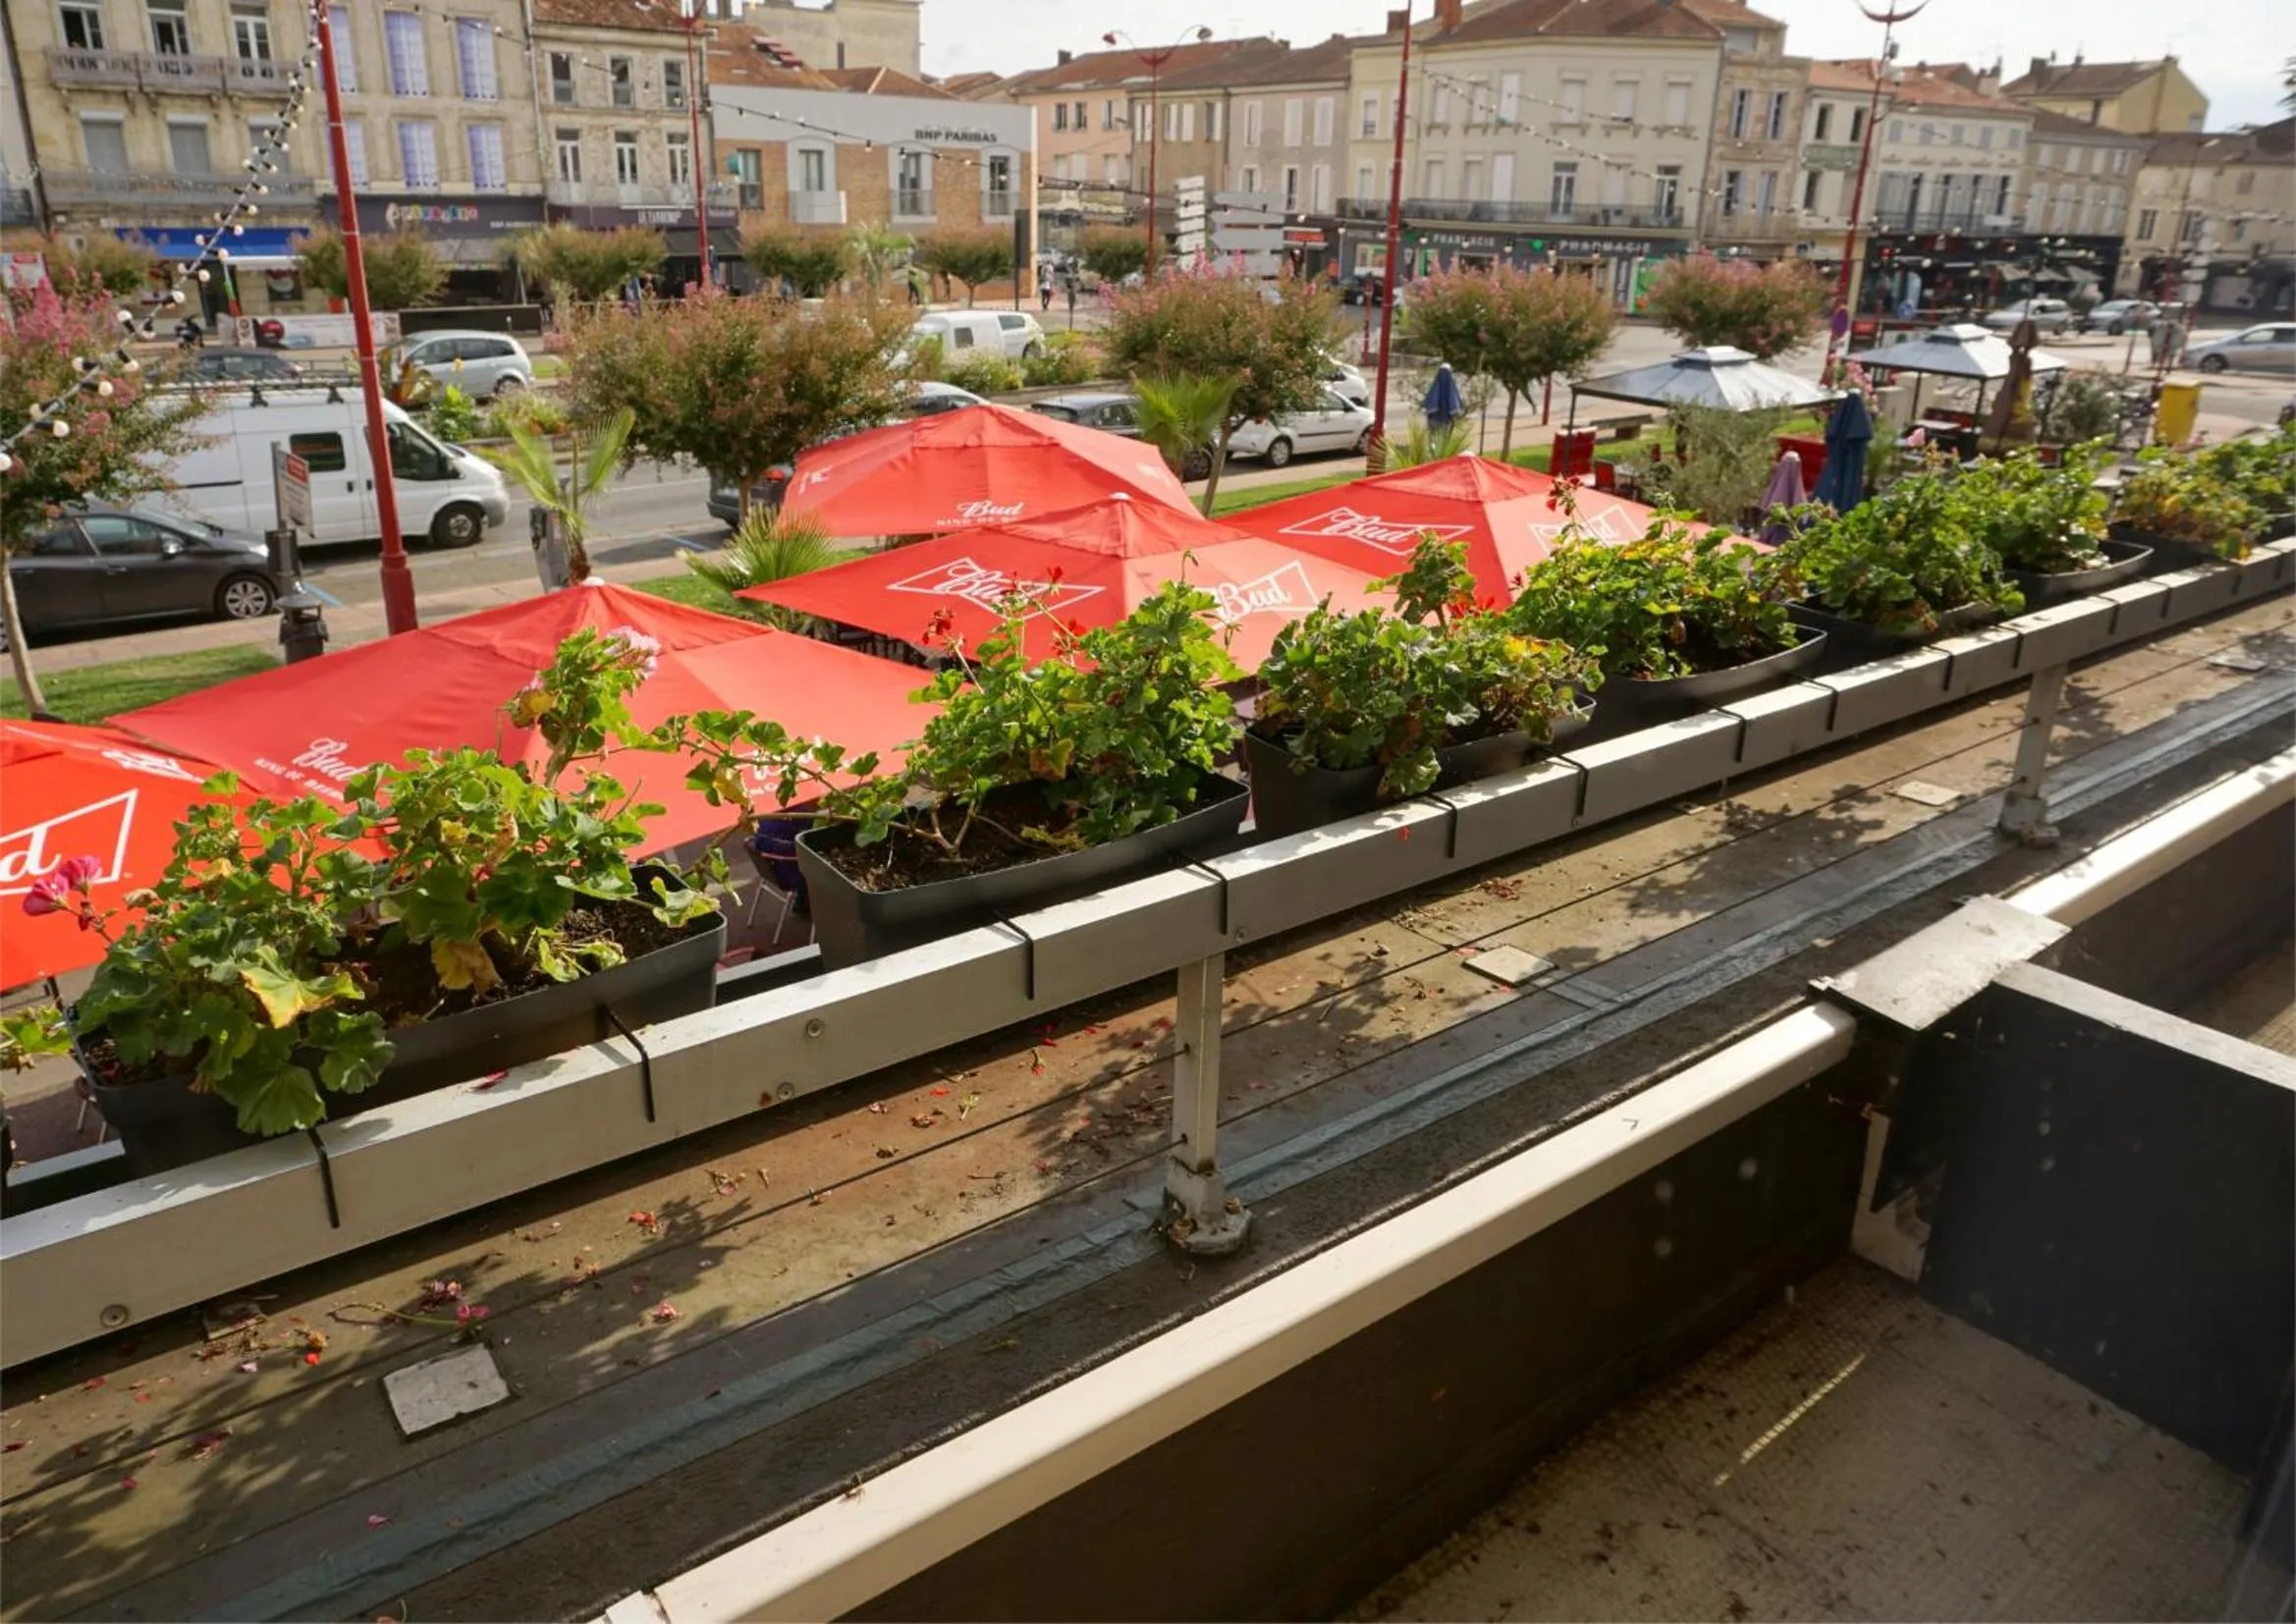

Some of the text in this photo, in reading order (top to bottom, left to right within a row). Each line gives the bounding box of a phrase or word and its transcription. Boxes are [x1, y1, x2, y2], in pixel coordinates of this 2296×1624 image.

[915, 129, 998, 142] BNP PARIBAS
[1433, 234, 1495, 246] PHARACIE
[956, 499, 1025, 518] Bud
[1321, 512, 1422, 543] Bud
[1215, 576, 1293, 623] Bud
[292, 737, 369, 782] Bud
